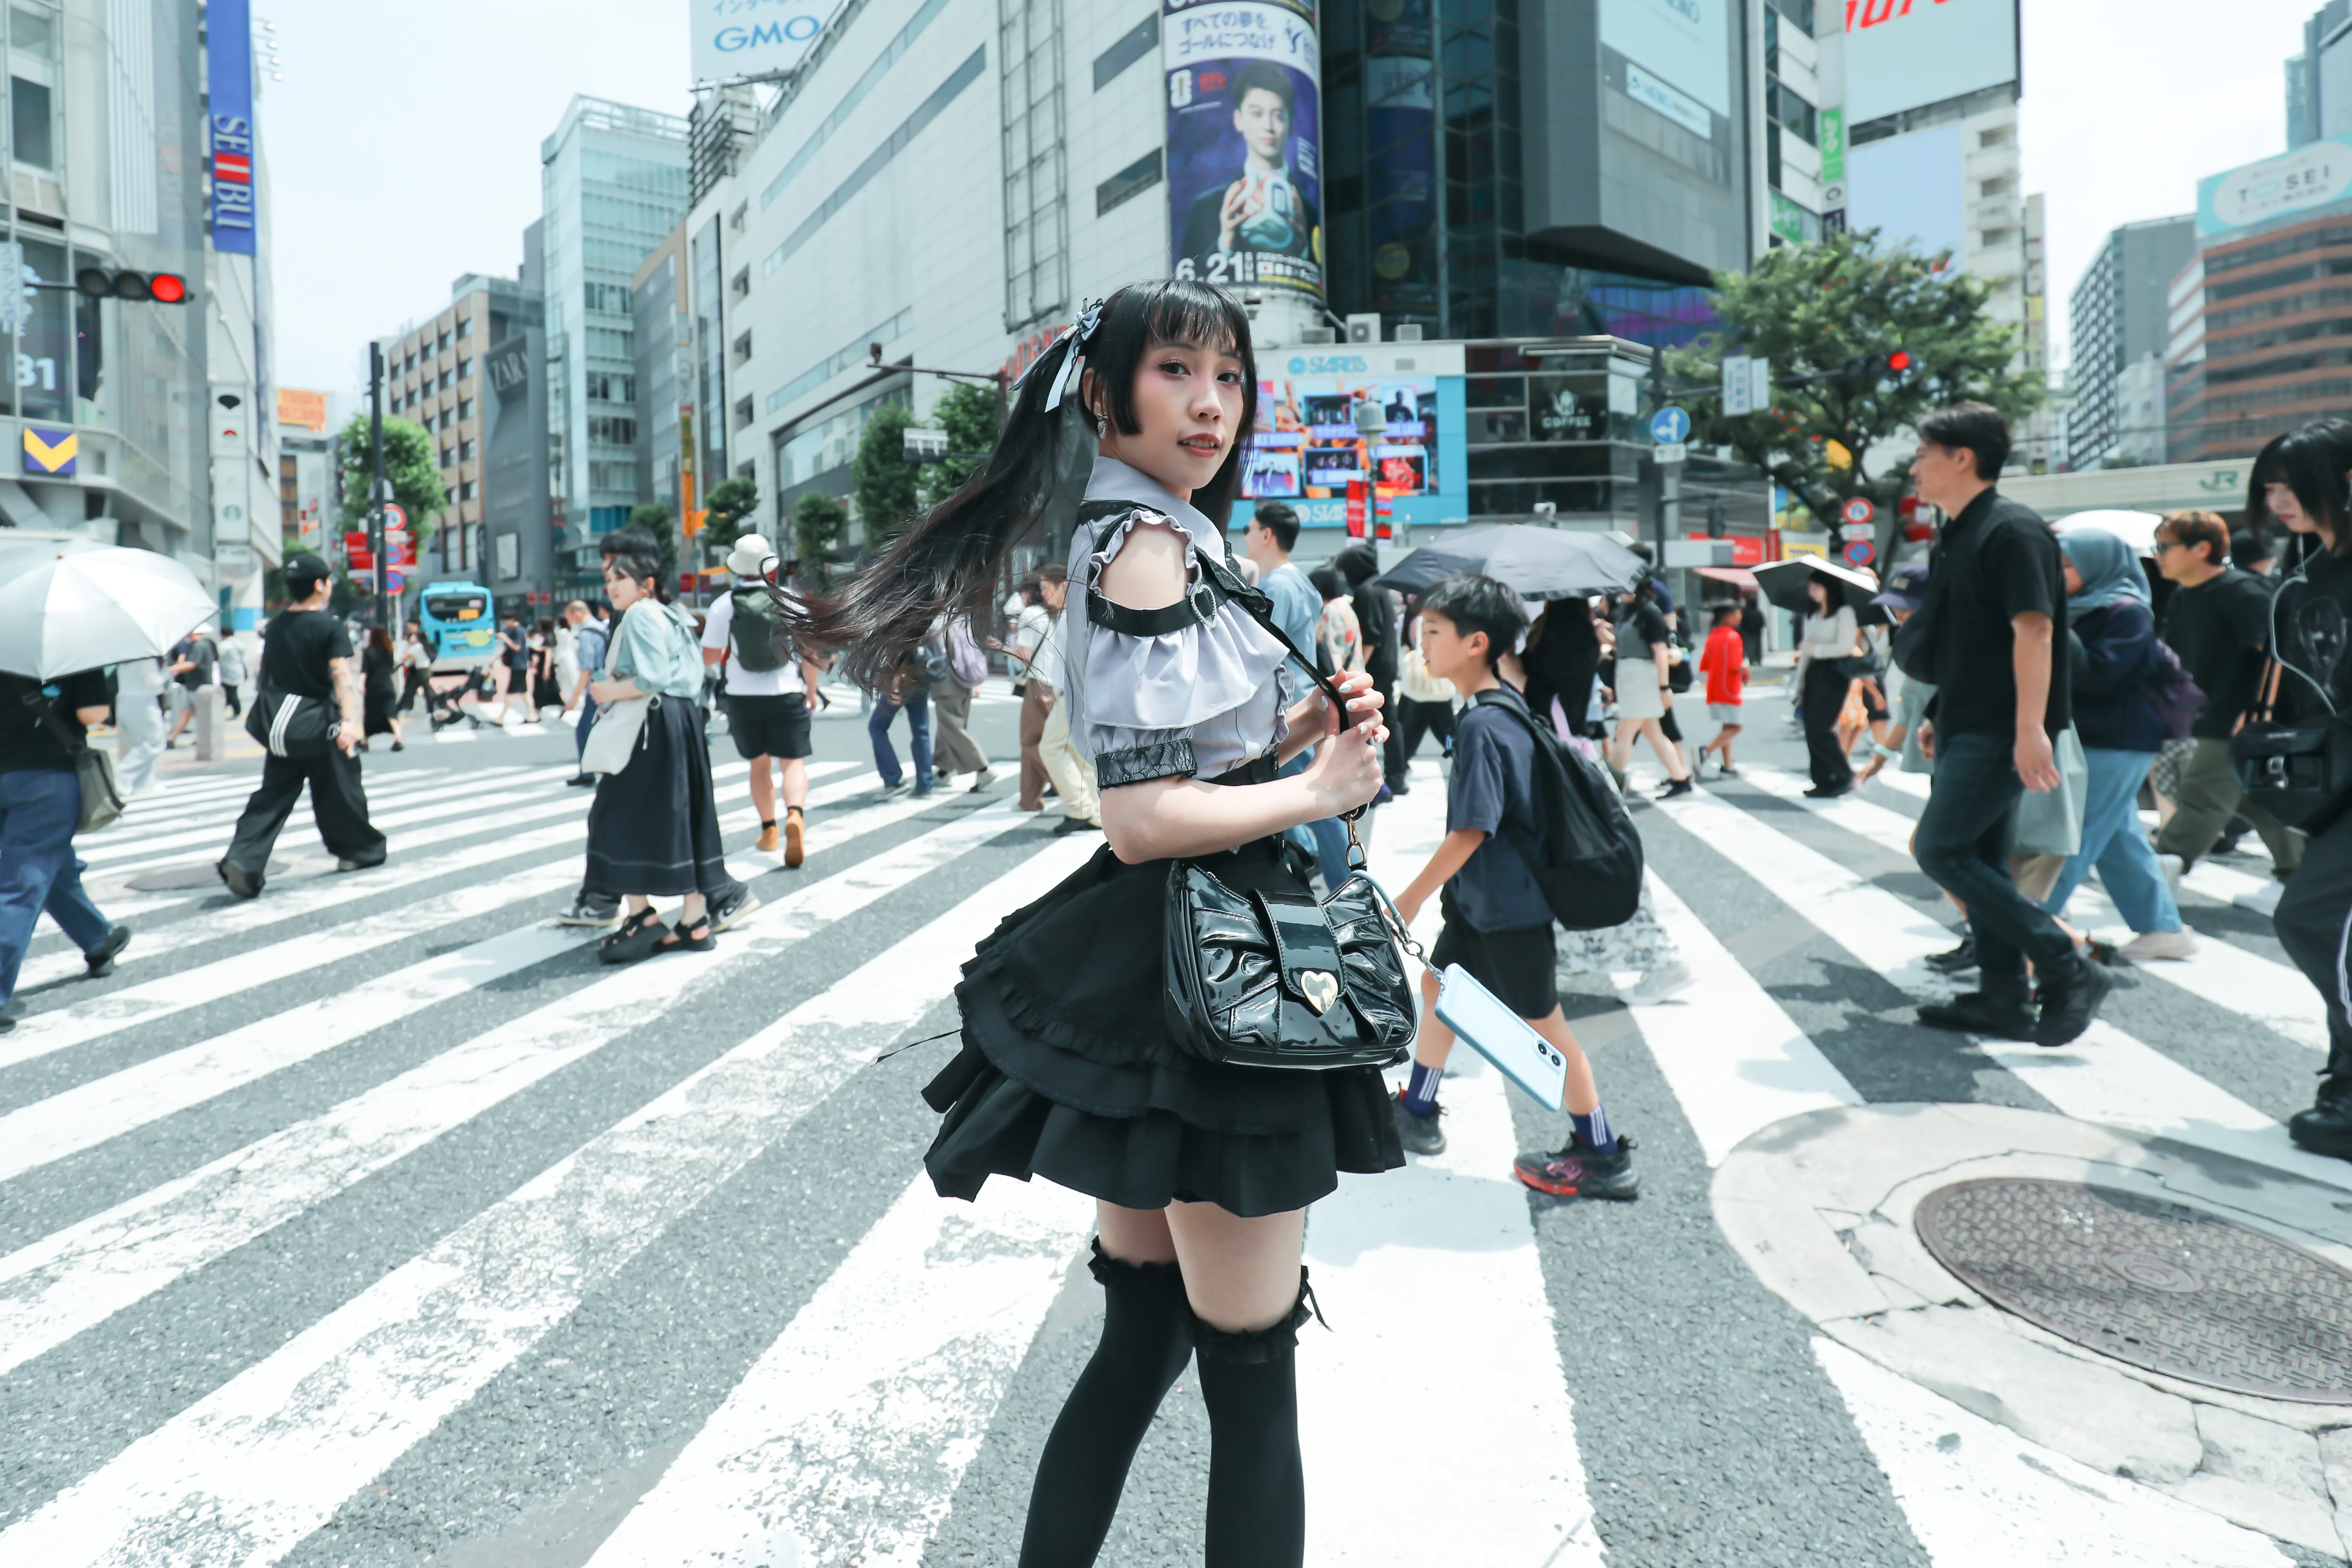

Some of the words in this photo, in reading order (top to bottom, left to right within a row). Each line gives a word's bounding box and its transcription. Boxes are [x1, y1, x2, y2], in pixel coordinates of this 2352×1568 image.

[713, 15, 820, 52] GMO
[213, 113, 252, 231] SEIBU
[2199, 470, 2238, 492] JR
